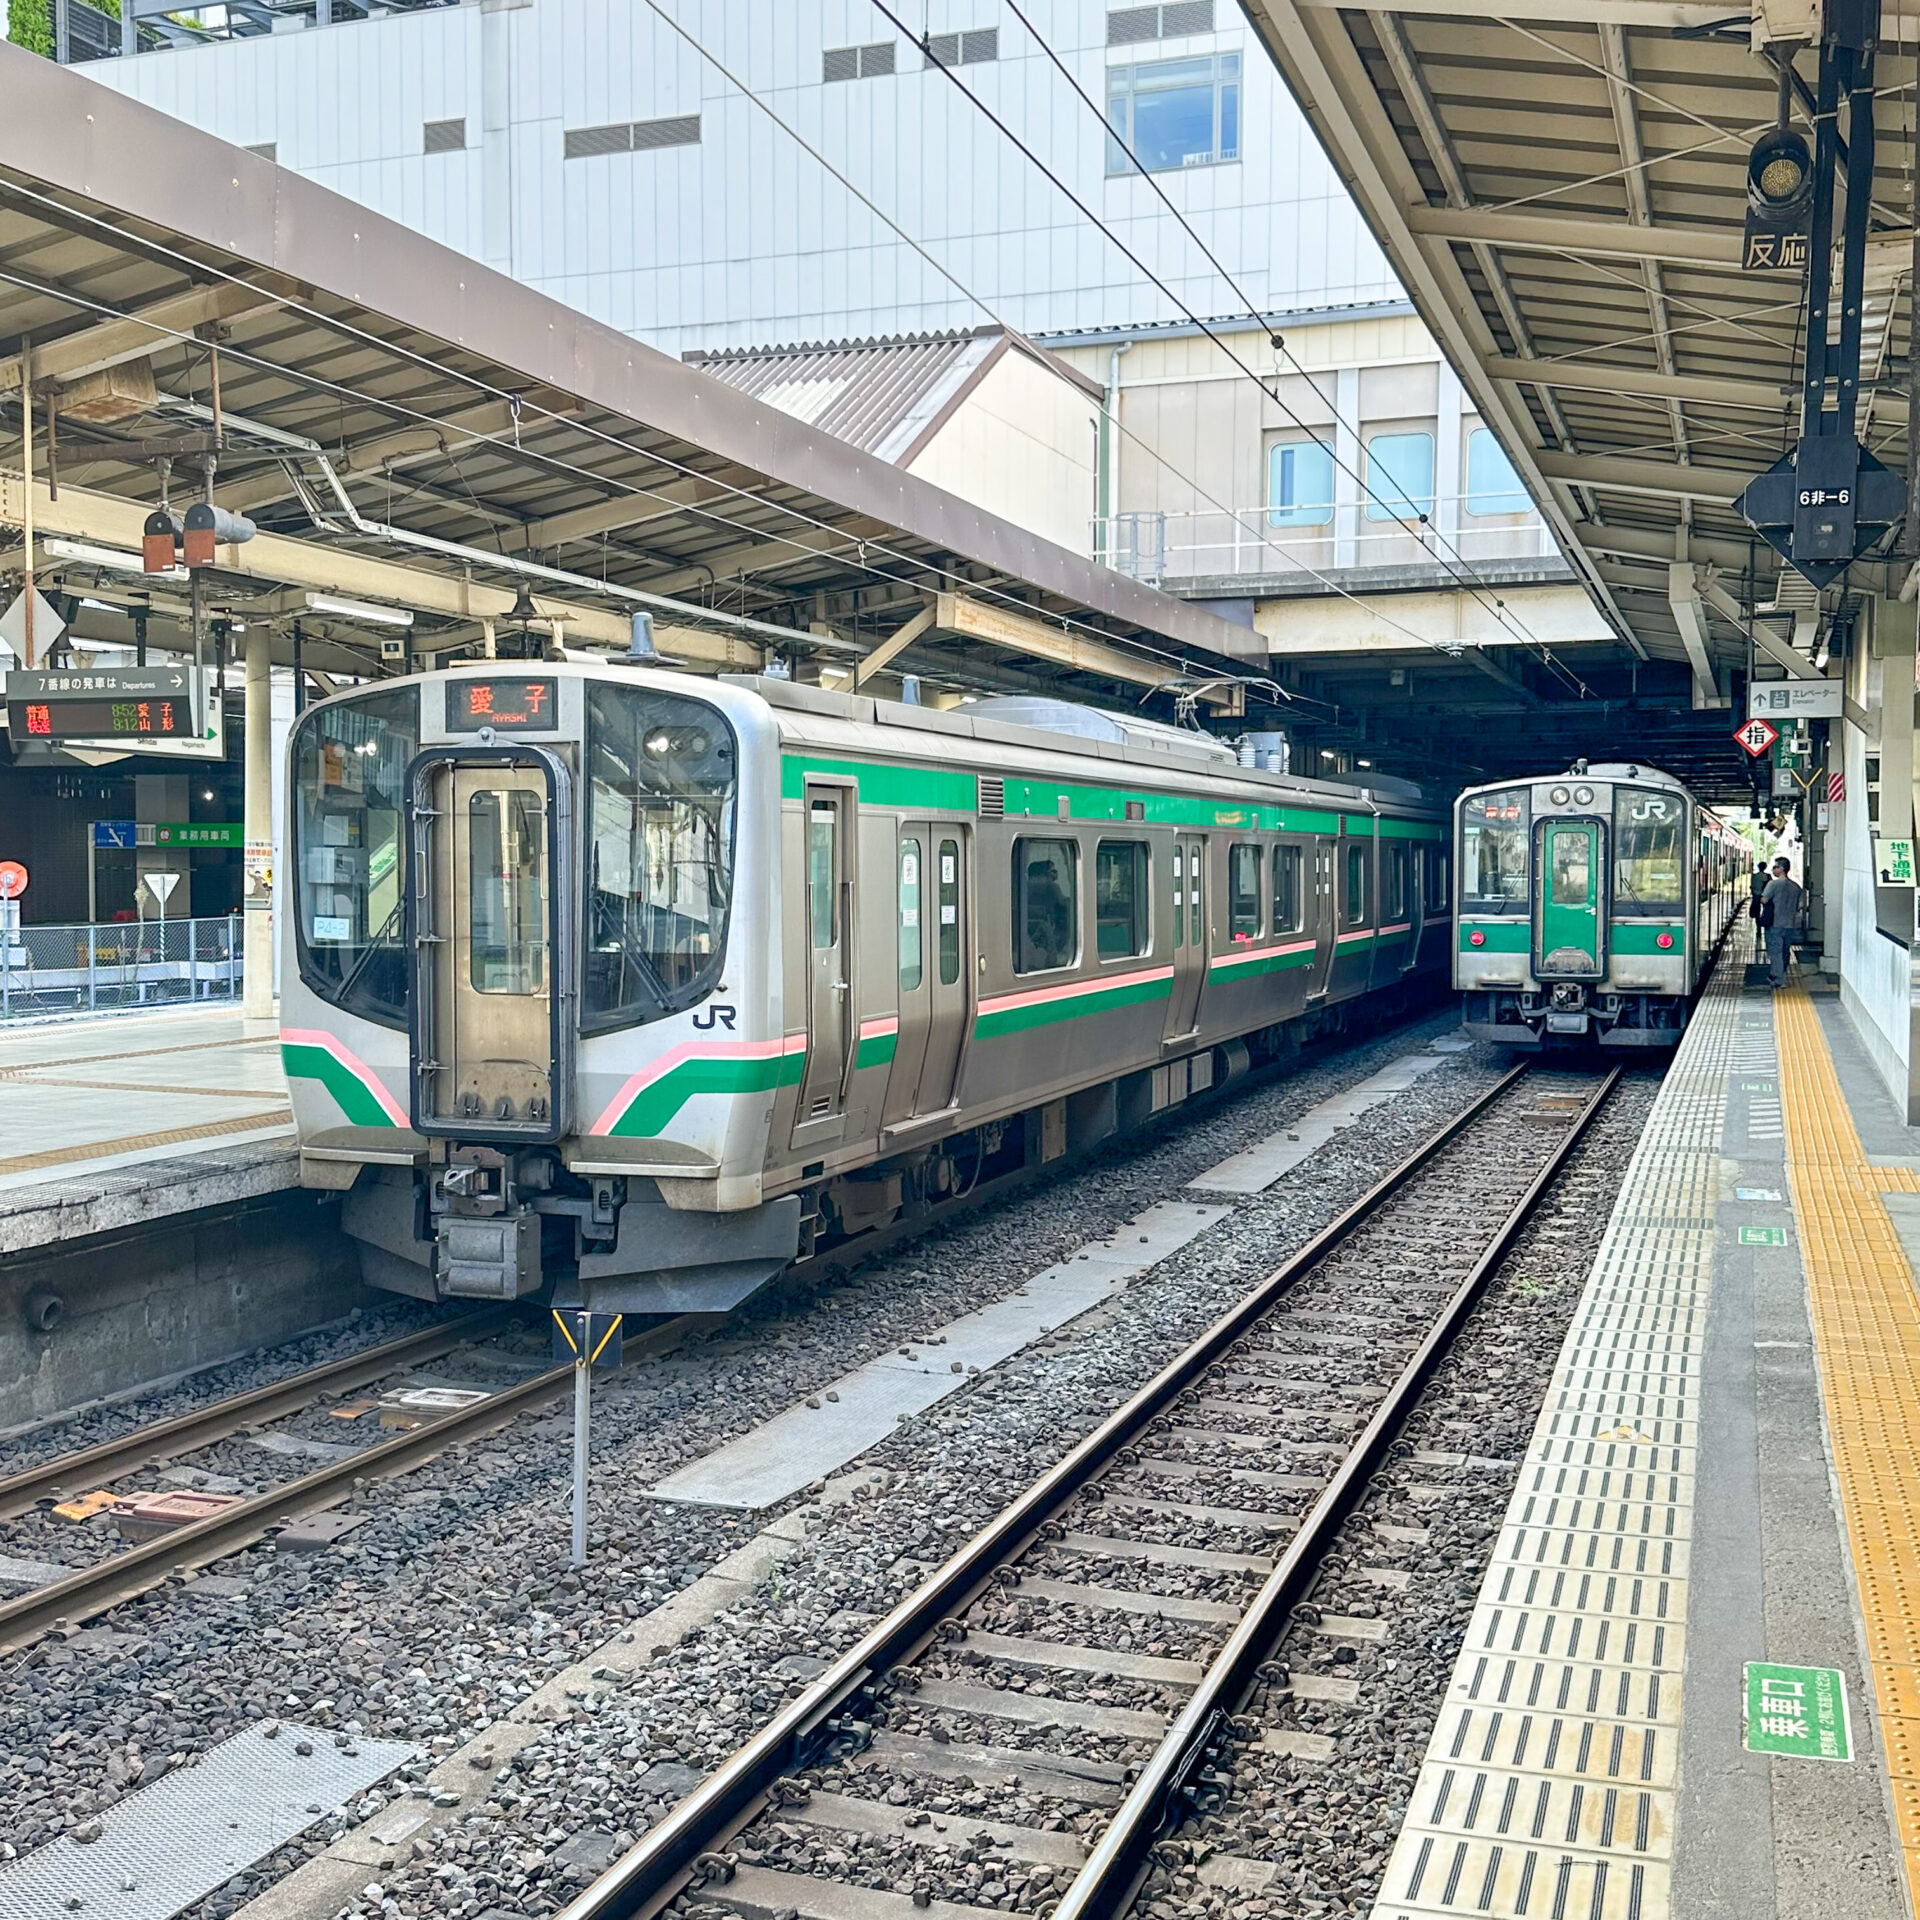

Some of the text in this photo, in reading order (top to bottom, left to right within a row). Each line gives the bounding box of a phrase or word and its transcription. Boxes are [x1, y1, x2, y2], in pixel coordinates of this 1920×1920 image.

[1746, 232, 1808, 267] 反応
[38, 677, 156, 692] 7番線の発車は Departures
[1793, 689, 1837, 698] エレベーター
[26, 704, 50, 720] 普通
[112, 705, 137, 718] 8:52
[492, 713, 528, 723] AYASHI
[113, 718, 138, 731] 9:12
[1747, 726, 1765, 744] 指
[1631, 801, 1666, 820] JR
[179, 830, 230, 841] 業務用車両
[1890, 842, 1911, 878] 地下通路
[693, 1005, 737, 1030] JR
[1759, 1678, 1809, 1739] 乗車口
